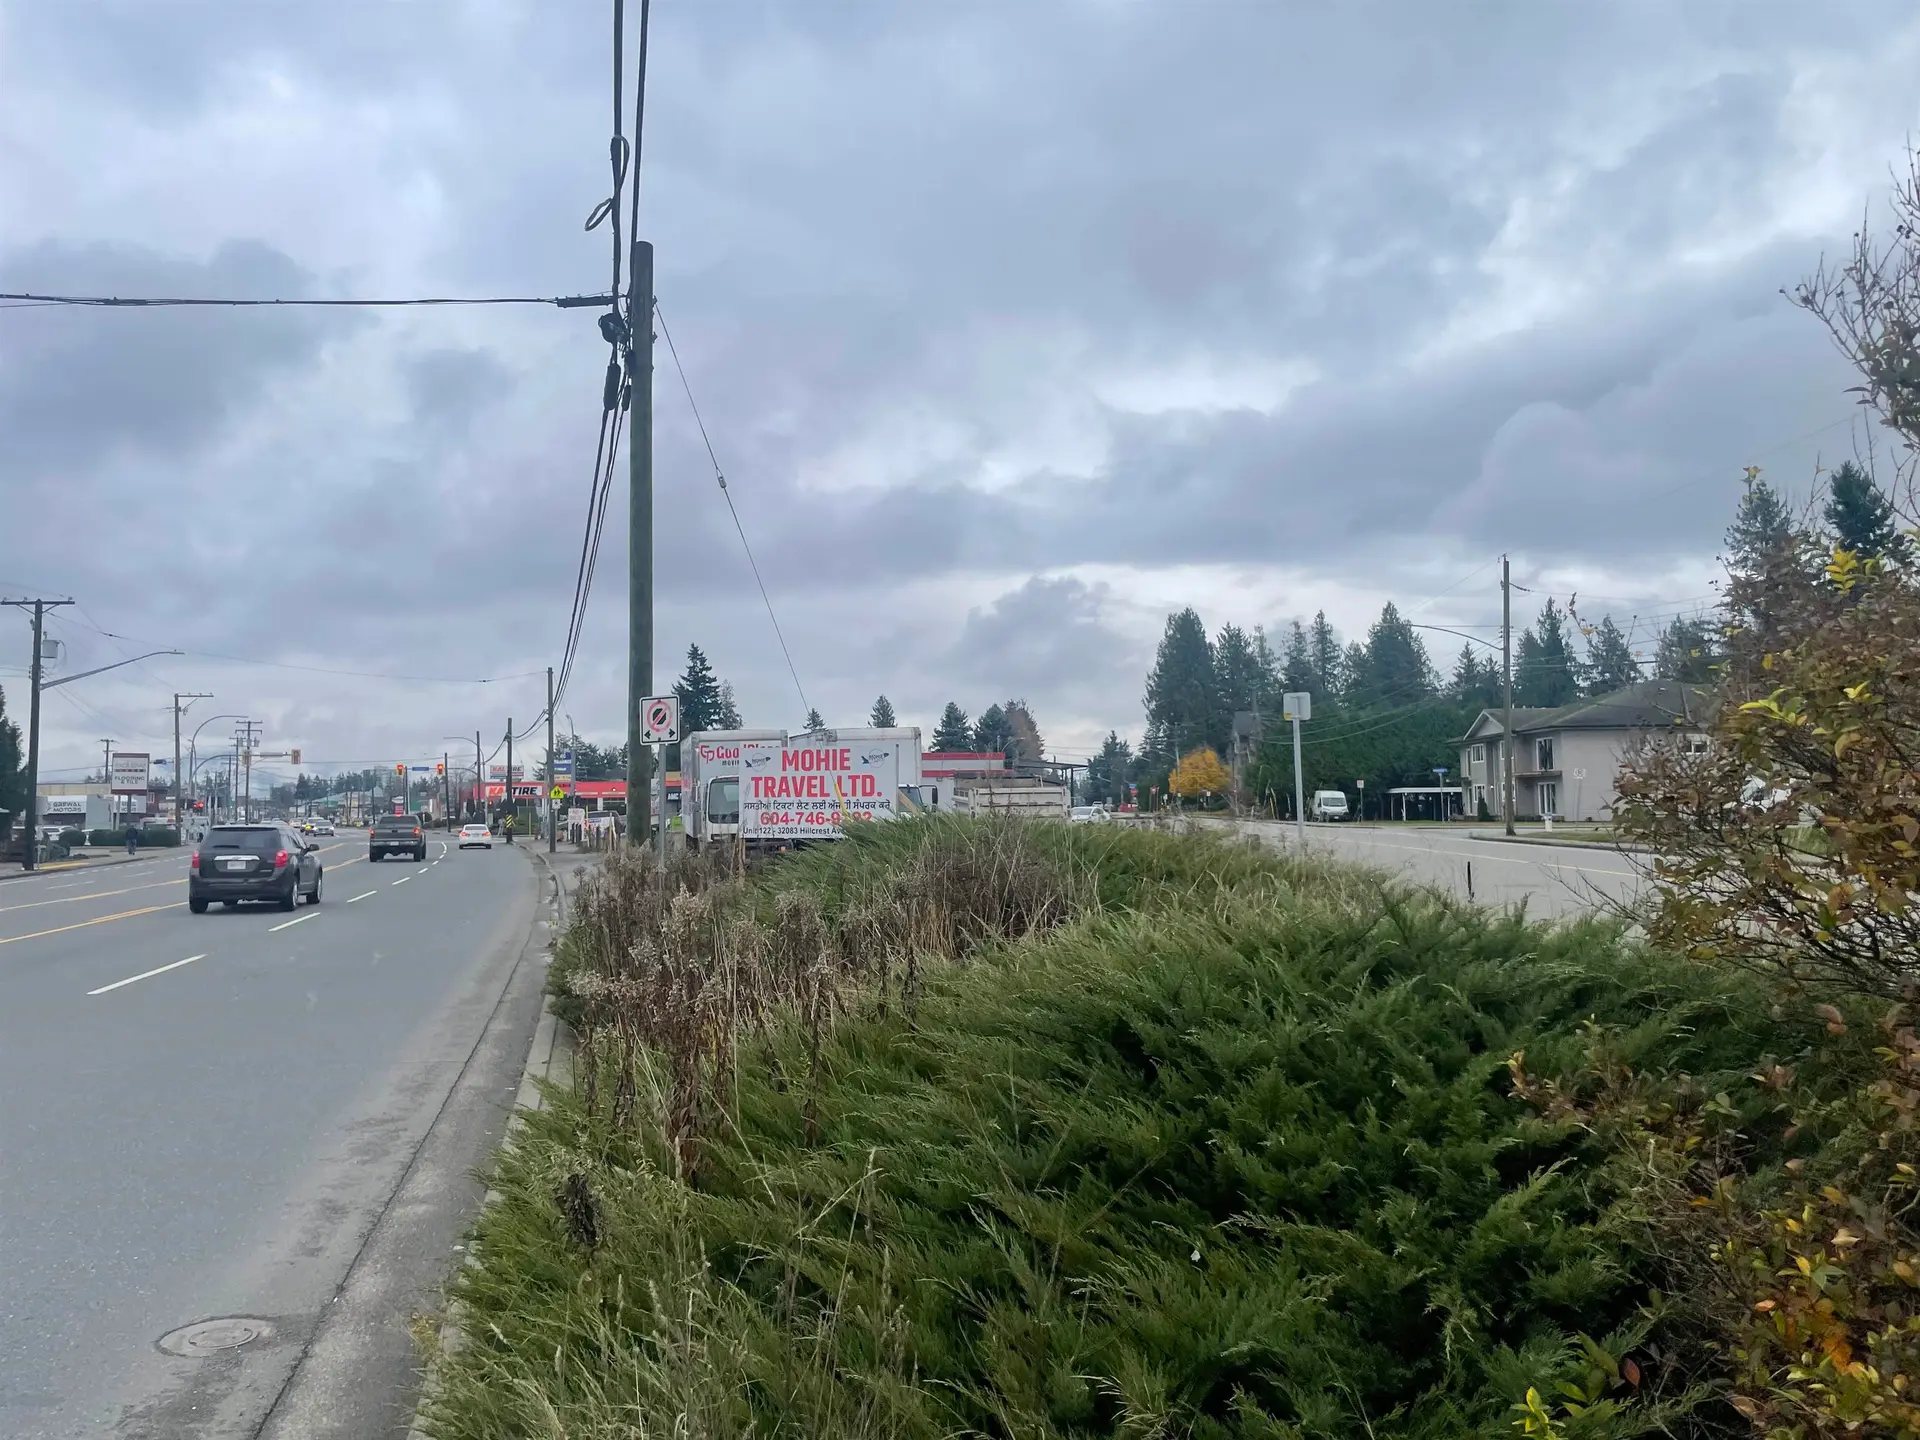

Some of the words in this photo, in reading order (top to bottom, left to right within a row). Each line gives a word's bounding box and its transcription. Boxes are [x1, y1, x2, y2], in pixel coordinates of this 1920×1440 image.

[782, 749, 850, 771] MOHIE
[511, 786, 538, 795] TIRE
[751, 776, 830, 797] TRAVEL
[837, 775, 882, 797] LTD.
[742, 827, 758, 835] Unit
[759, 827, 771, 835] 122
[777, 827, 798, 835] 32083
[799, 826, 830, 835] Hillcrest
